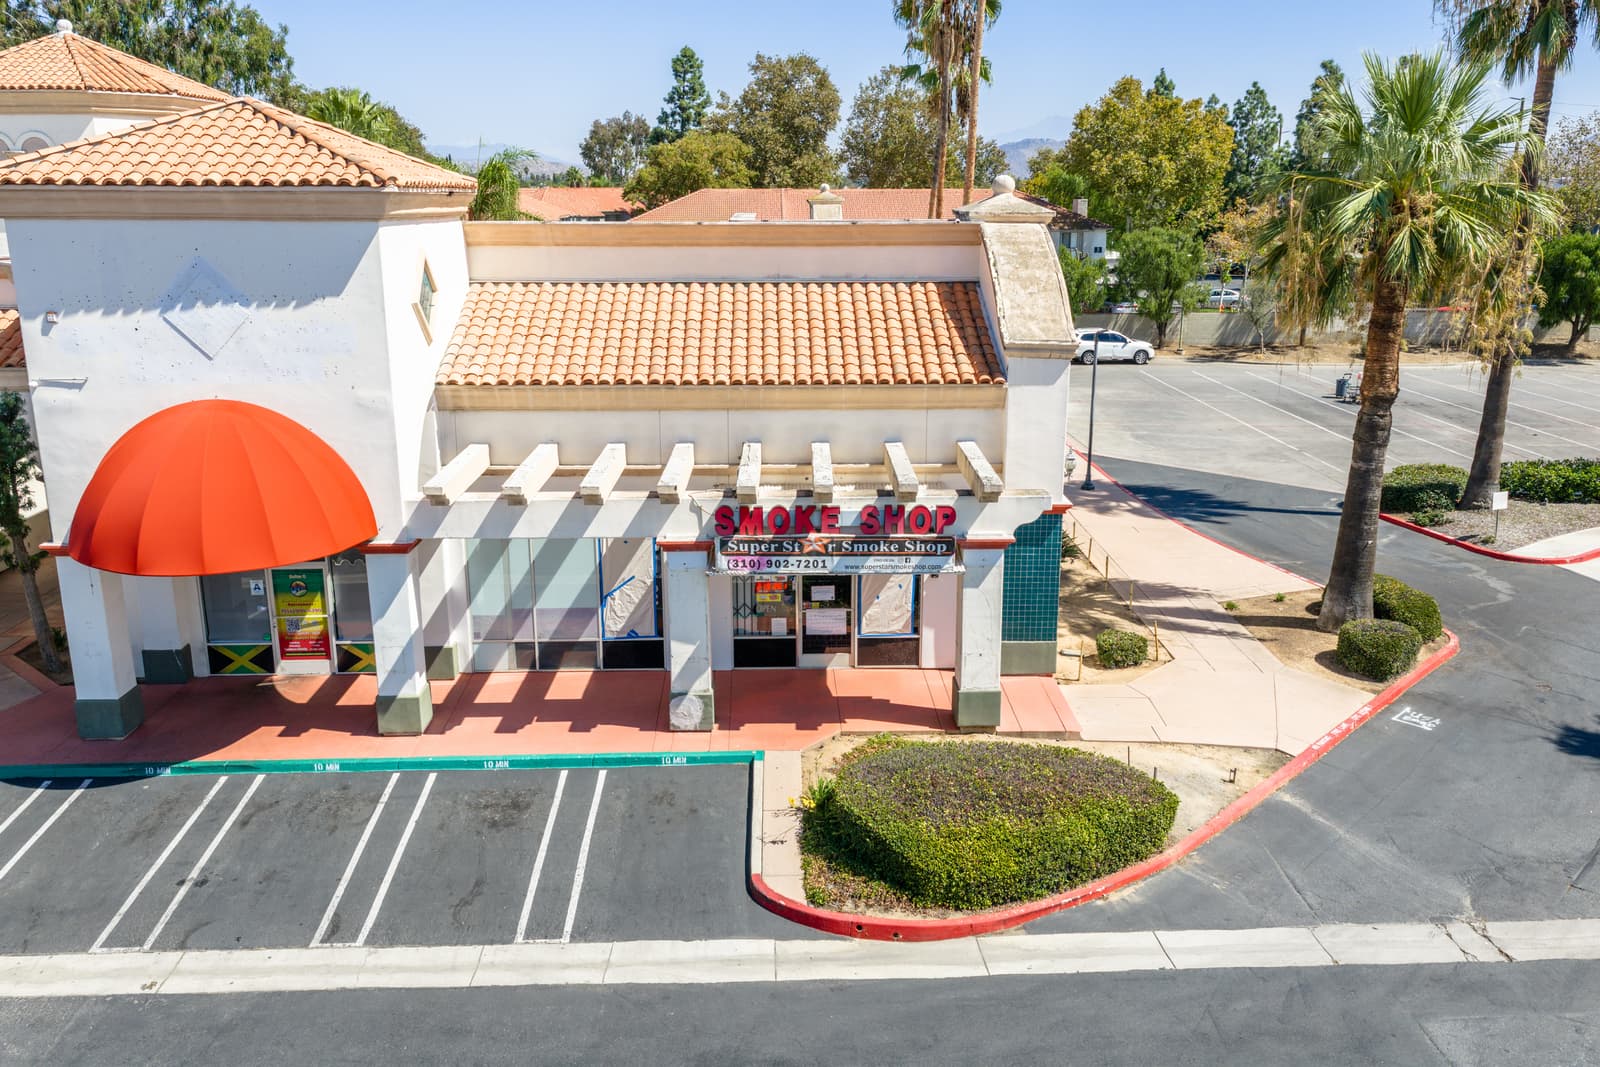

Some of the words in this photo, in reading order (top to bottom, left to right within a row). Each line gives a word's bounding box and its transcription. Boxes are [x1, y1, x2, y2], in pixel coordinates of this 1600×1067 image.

[715, 505, 840, 536] SMOKE
[860, 505, 956, 535] SHOP
[727, 540, 778, 554] Super
[782, 540, 836, 552] Str
[841, 540, 899, 552] Smoke
[904, 540, 947, 554] Shop
[727, 559, 761, 570] (310)
[766, 559, 828, 568] 902-7201
[253, 583, 261, 591] A
[314, 763, 323, 771] 10
[325, 763, 340, 771] MIN
[495, 760, 509, 768] MIN
[145, 767, 154, 775] 10
[156, 767, 171, 775] MIN
